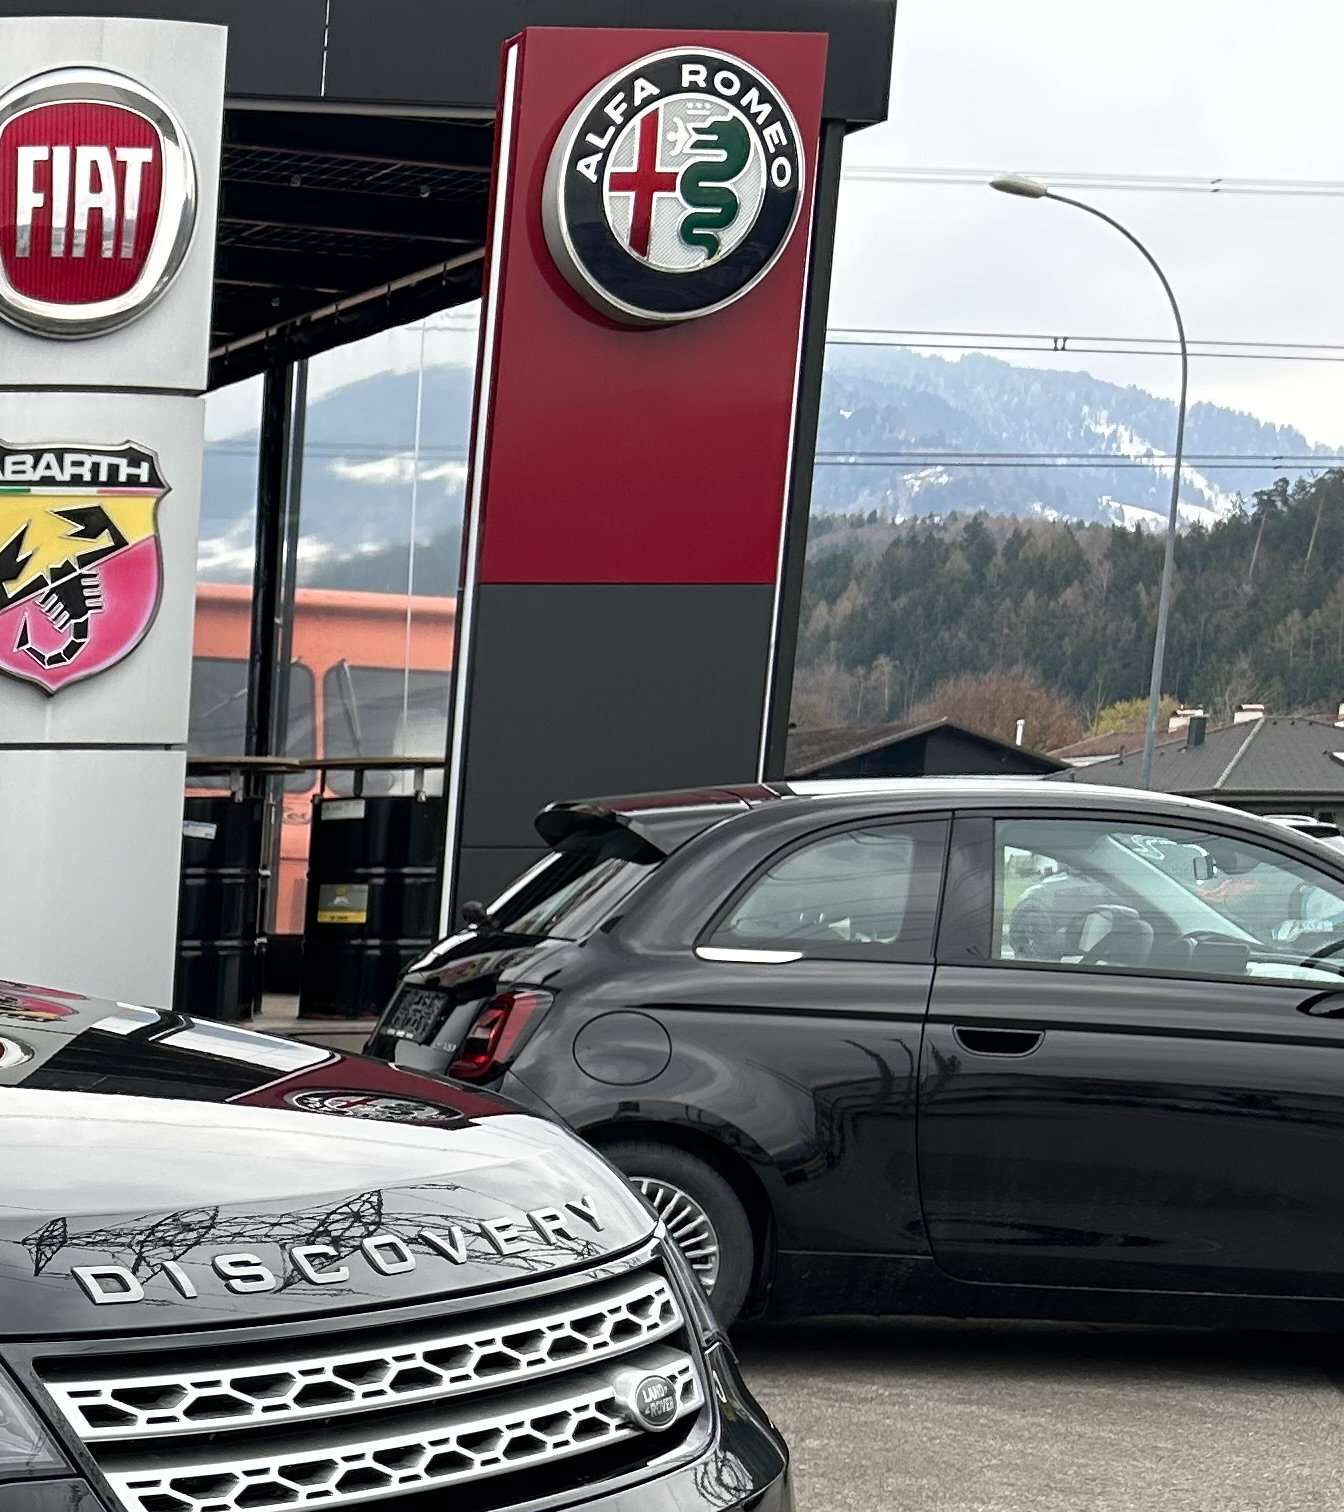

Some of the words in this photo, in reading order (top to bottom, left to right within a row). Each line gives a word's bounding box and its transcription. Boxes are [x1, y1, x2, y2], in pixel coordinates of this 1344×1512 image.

[576, 76, 662, 183] ALFA
[681, 62, 794, 190] ROMEO
[14, 144, 153, 259] FIAT
[71, 1194, 609, 1305] DISCOVERY
[642, 1383, 665, 1404] LAND
[650, 1395, 675, 1418] ROVER
